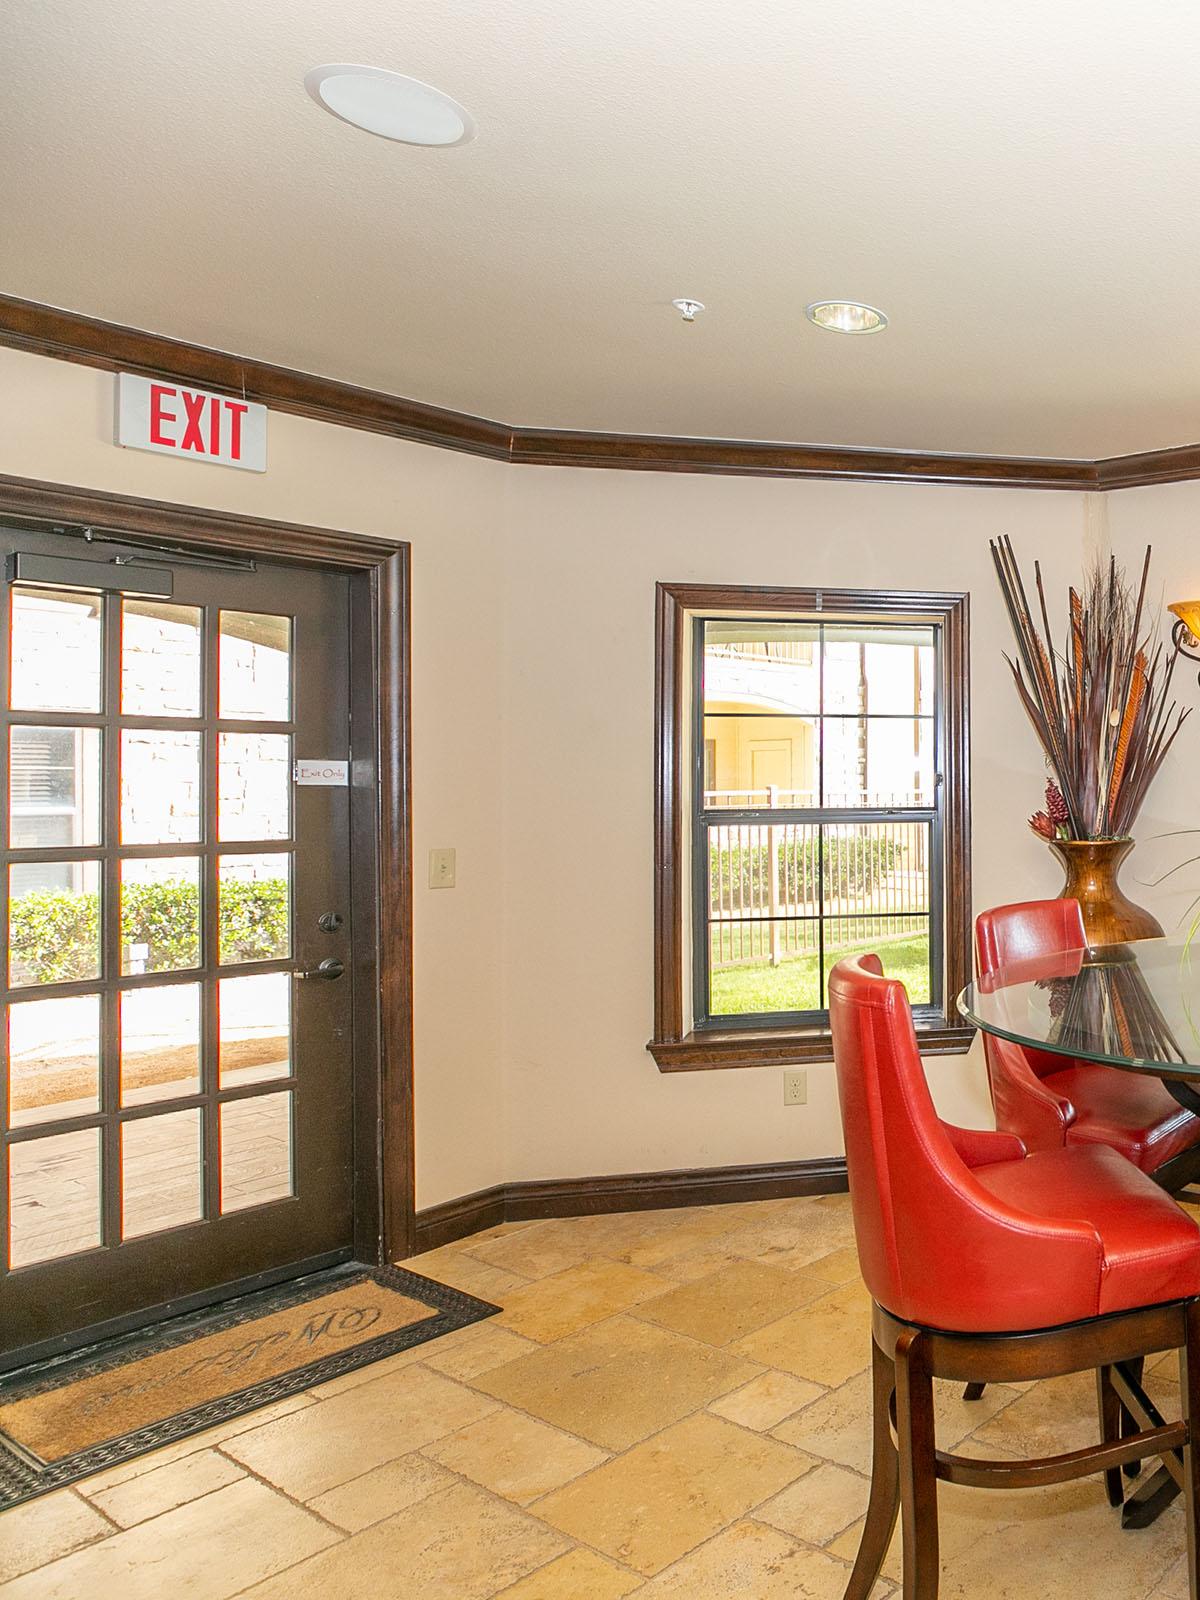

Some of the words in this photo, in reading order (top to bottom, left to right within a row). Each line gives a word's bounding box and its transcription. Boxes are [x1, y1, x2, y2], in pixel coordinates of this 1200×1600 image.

[151, 384, 248, 460] EXIT
[301, 768, 321, 778] Exit
[322, 768, 345, 780] Only
